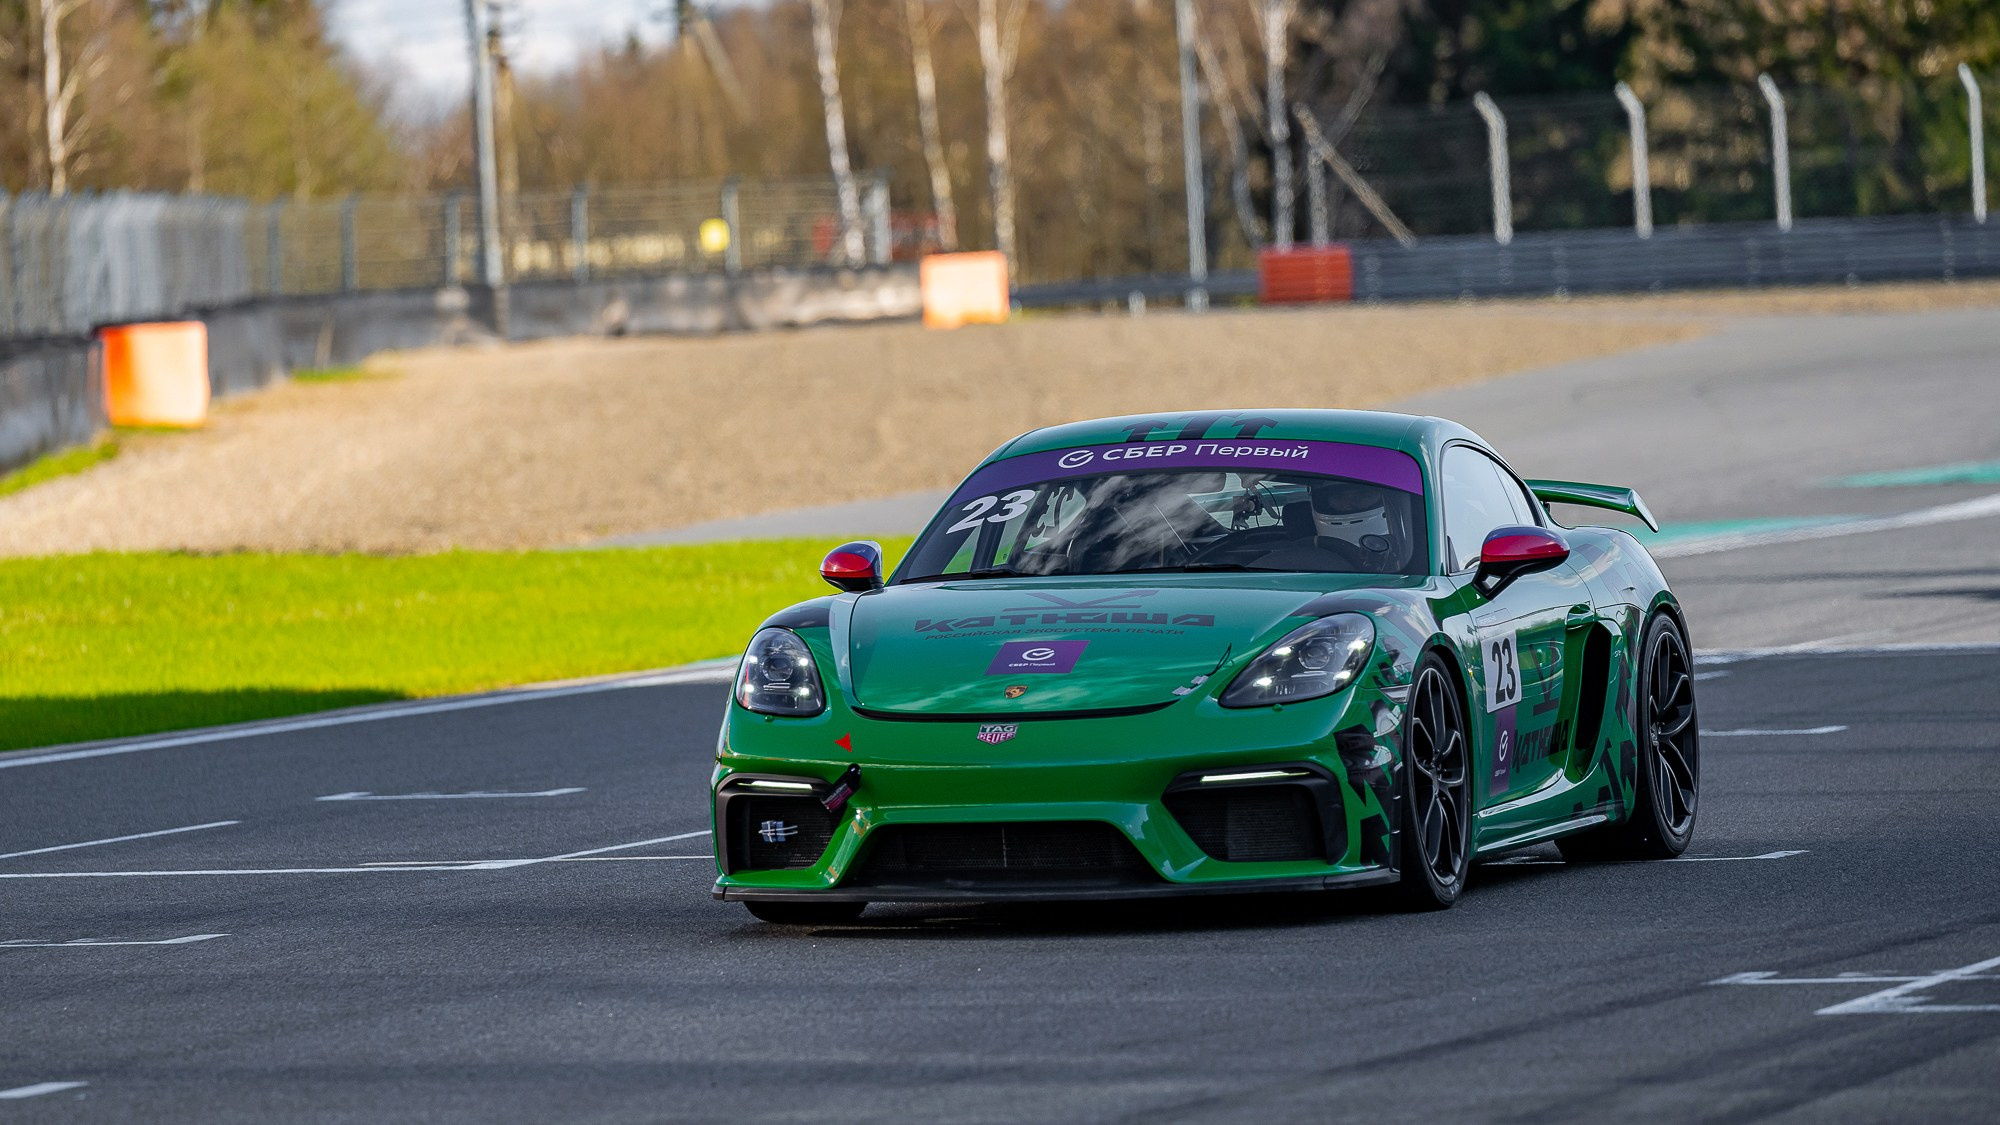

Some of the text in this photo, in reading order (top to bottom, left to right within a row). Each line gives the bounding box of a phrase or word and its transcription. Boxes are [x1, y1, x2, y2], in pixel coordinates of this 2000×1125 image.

[1102, 444, 1309, 461] СБЕР Первый
[946, 490, 1036, 534] 23
[914, 612, 1215, 633] КАТЮША
[925, 629, 1021, 640] РОССИЙСКАЯ
[1126, 627, 1185, 635] ПЕЧАТИ
[1491, 637, 1516, 705] 23
[983, 725, 1014, 733] TAG
[979, 732, 1013, 744] HEUER
